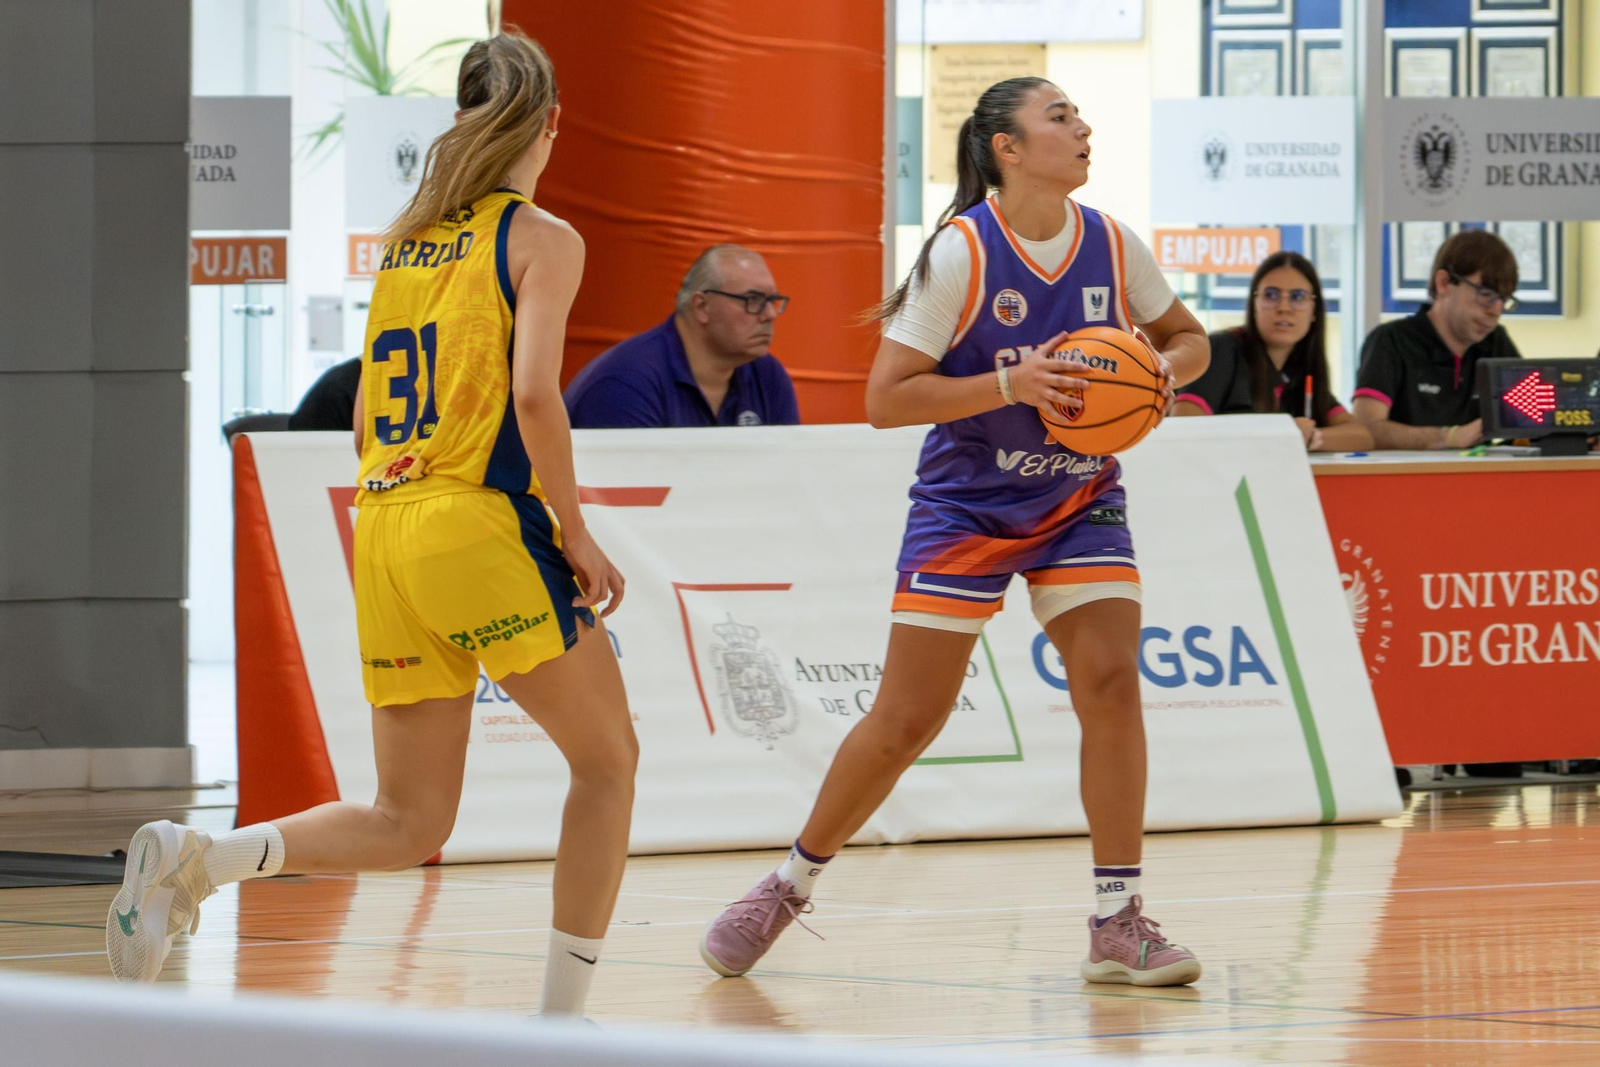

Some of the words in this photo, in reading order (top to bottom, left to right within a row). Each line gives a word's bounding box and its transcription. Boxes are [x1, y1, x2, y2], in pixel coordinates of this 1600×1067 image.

[1244, 142, 1342, 157] UNIVERSIDAD
[1244, 163, 1263, 178] DE
[1264, 161, 1341, 178] GRANADA
[1485, 164, 1514, 187] DE
[1160, 235, 1270, 266] EMPUJAR
[372, 321, 440, 446] 31
[1019, 453, 1049, 477] El
[1419, 567, 1600, 610] UNIVERS
[473, 613, 521, 637] caixa
[478, 611, 549, 648] popular
[1030, 624, 1279, 692] GGSA
[1418, 629, 1474, 668] DE
[819, 696, 851, 717] DE
